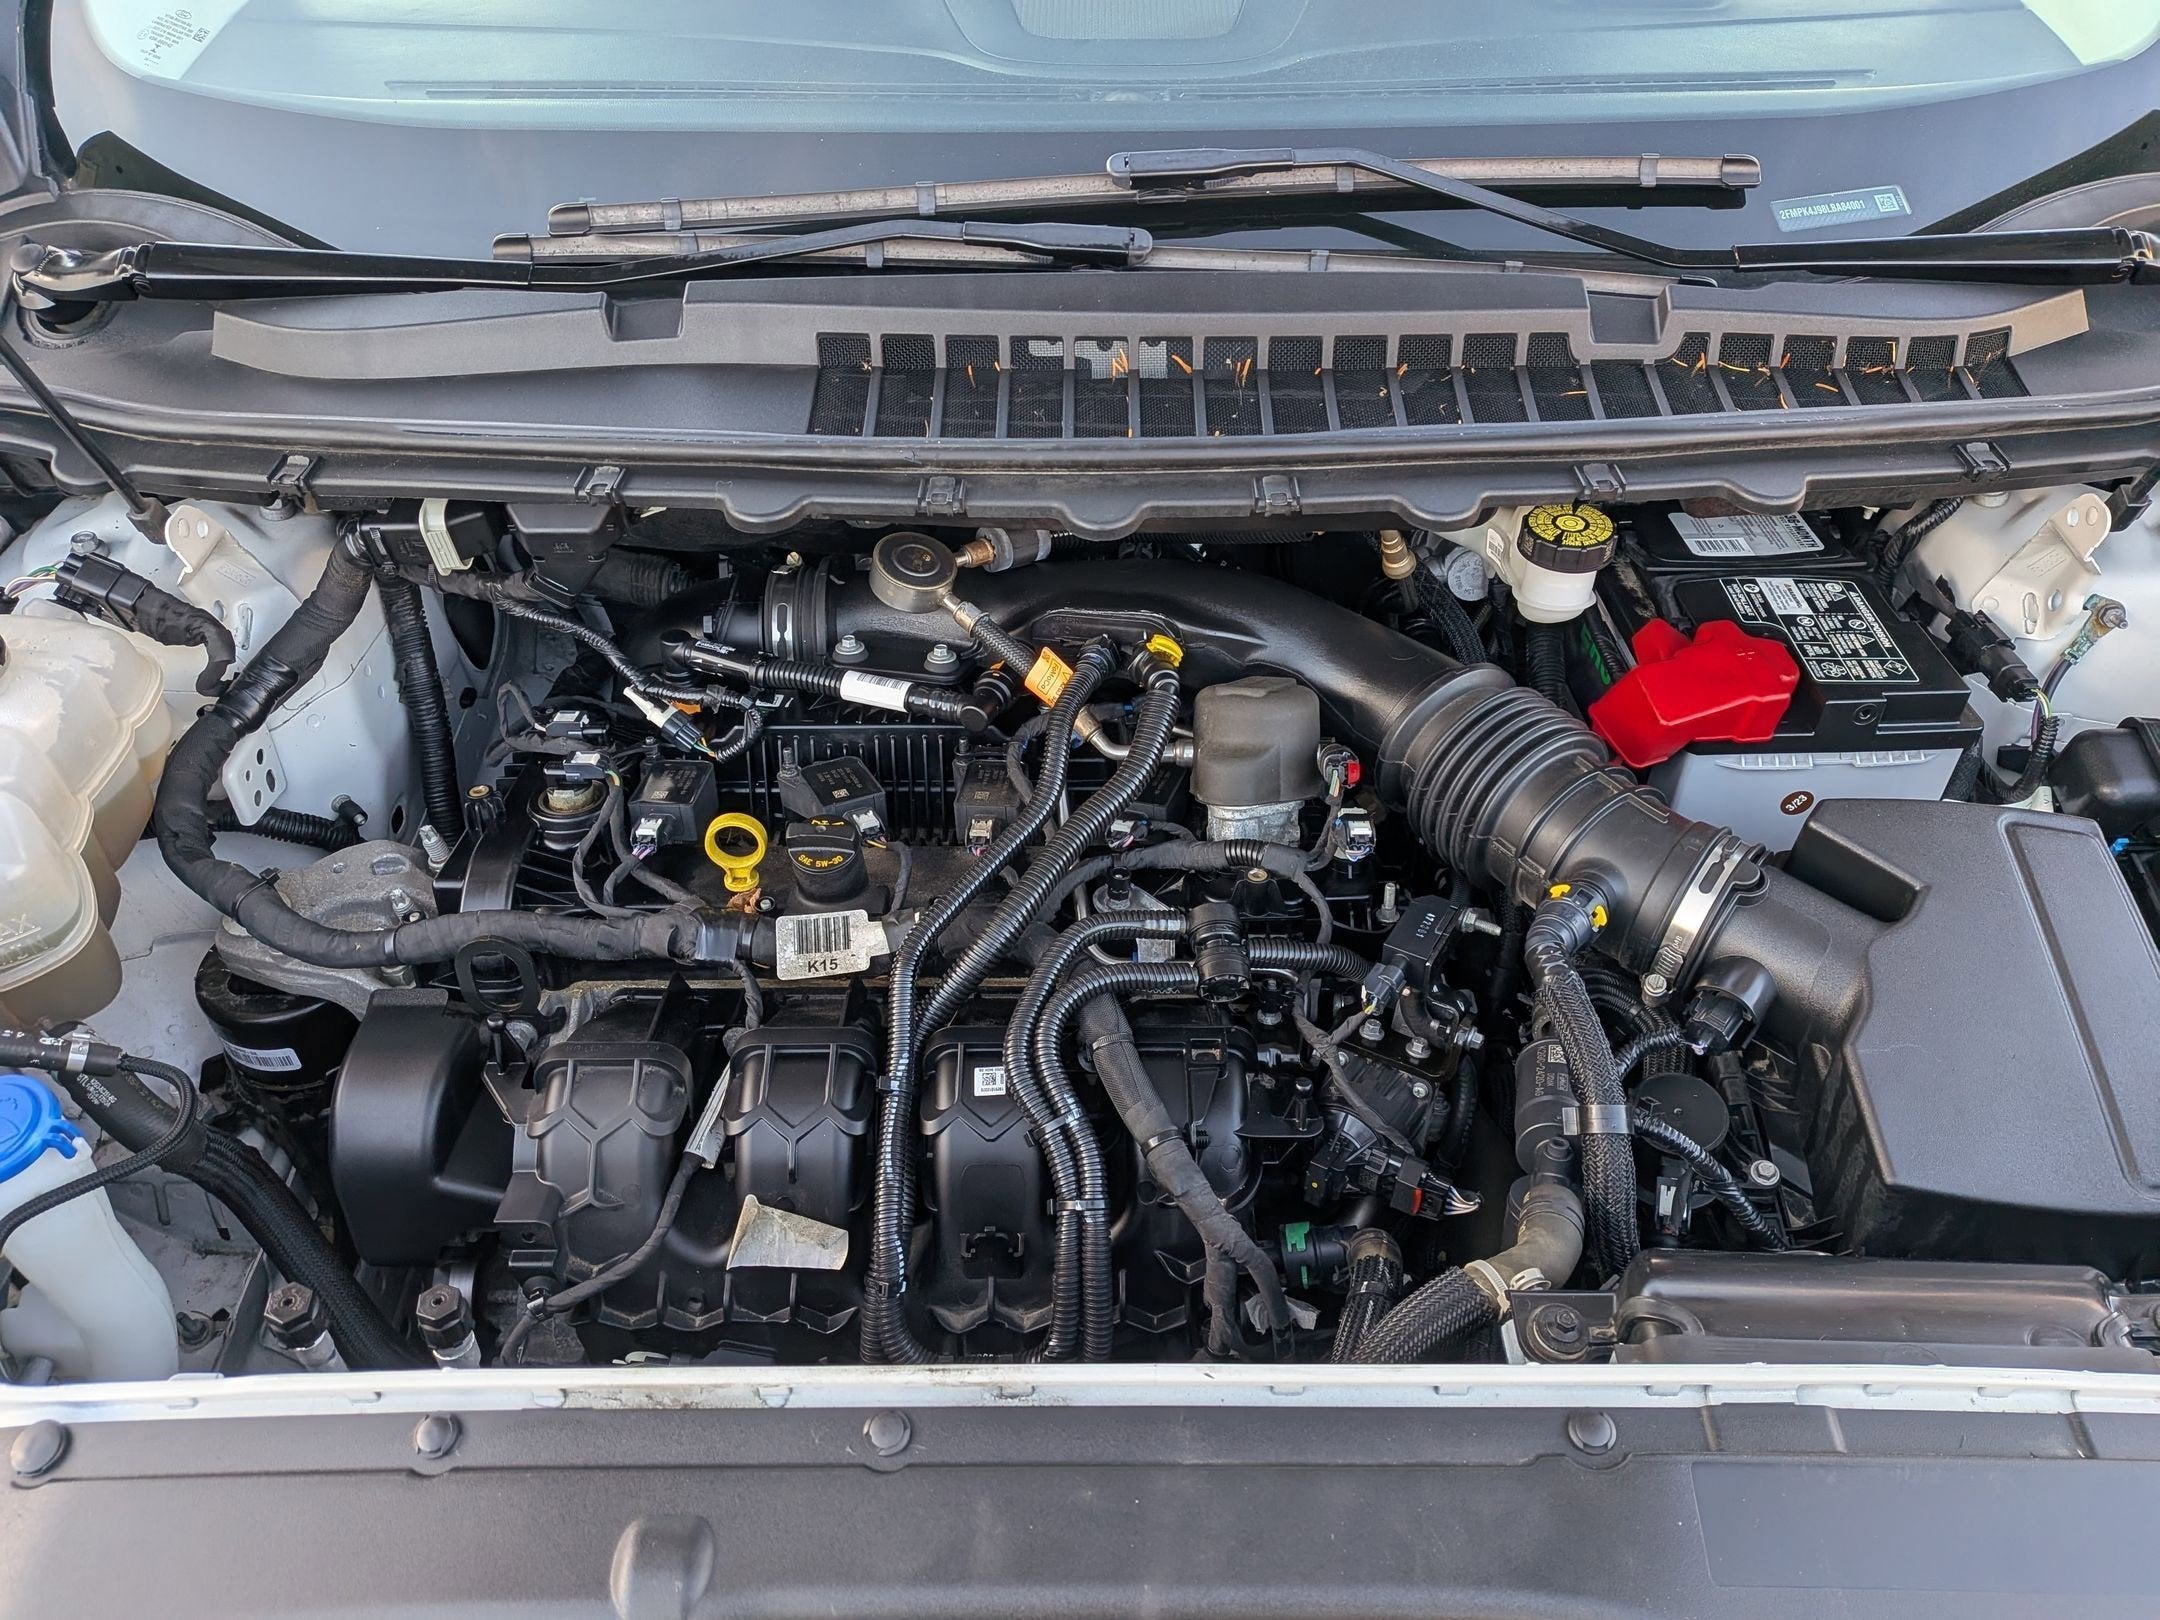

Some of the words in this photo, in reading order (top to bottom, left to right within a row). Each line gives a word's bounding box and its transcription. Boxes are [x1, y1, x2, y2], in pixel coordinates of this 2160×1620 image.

[1785, 793, 1808, 811] 3/23
[797, 853, 813, 866] SAE
[815, 854, 843, 867] 5W-30
[807, 958, 837, 973] K15
